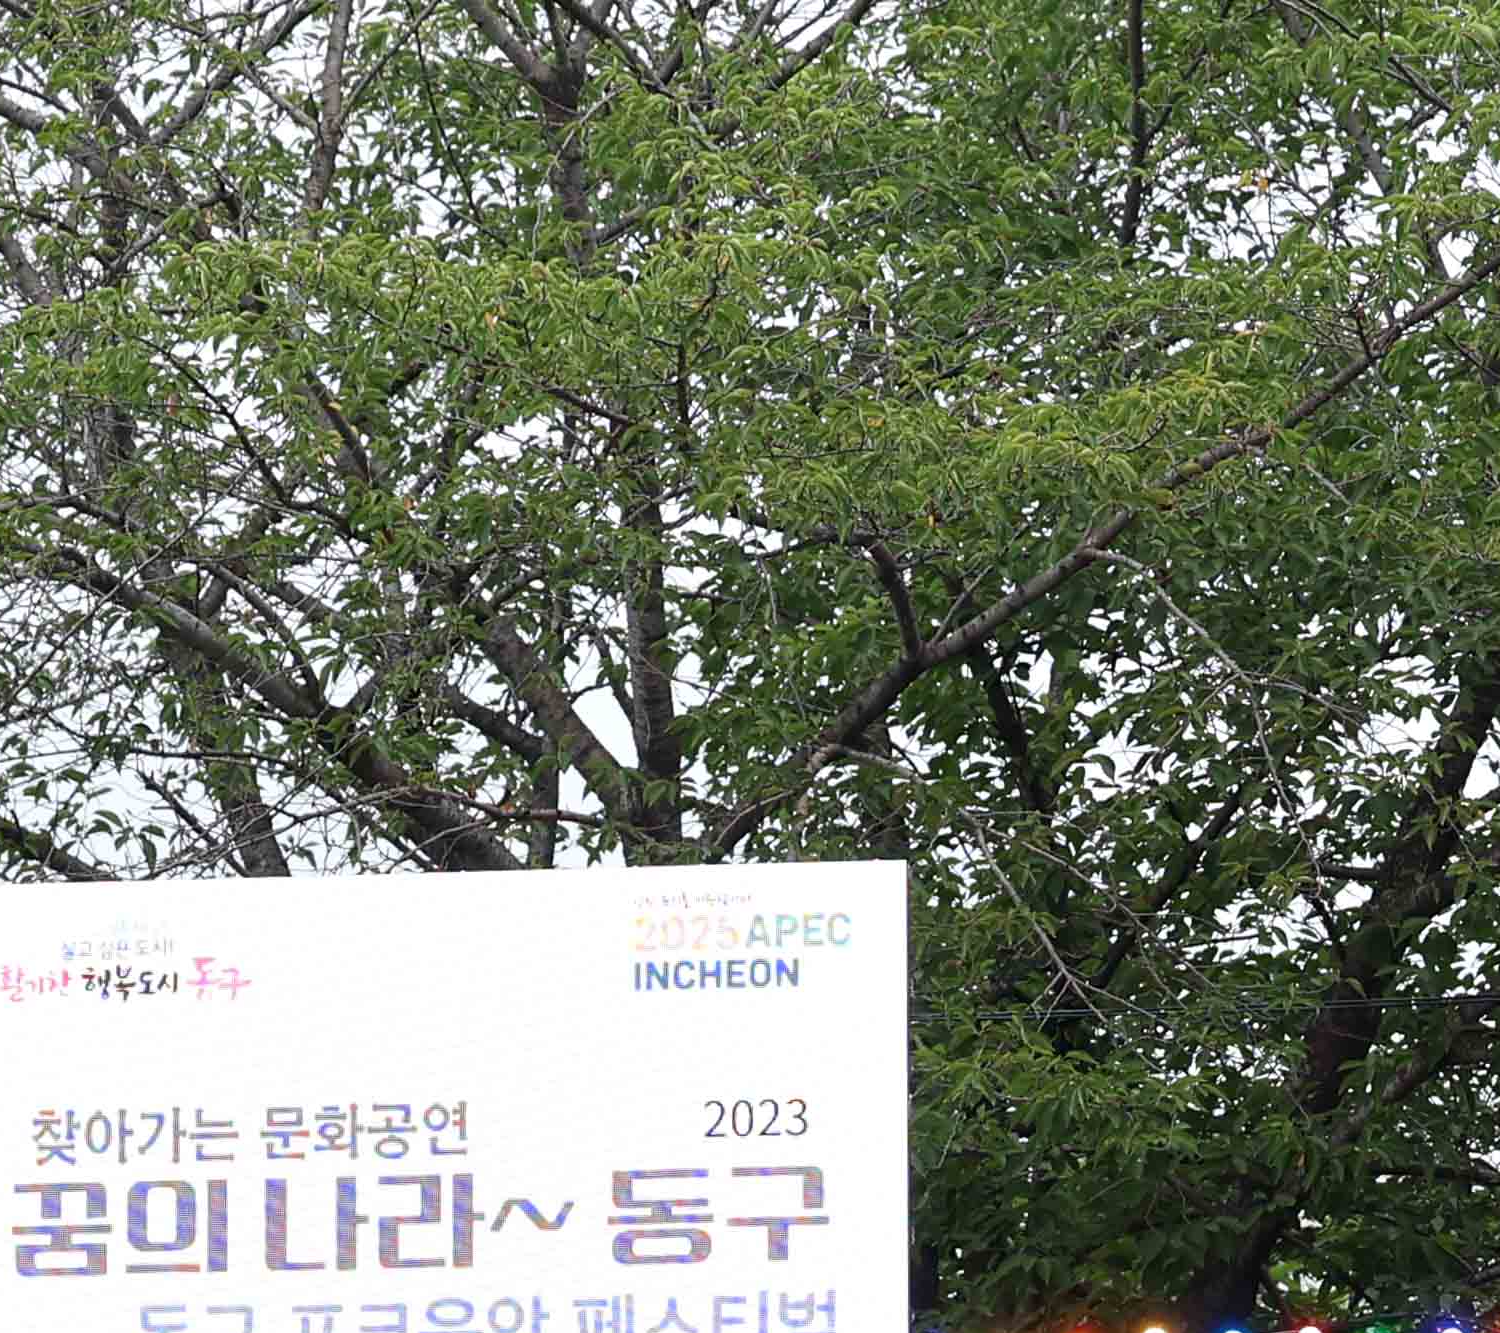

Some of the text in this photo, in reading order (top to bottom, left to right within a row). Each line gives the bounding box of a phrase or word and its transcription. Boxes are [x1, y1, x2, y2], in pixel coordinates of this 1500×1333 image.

[745, 912, 852, 949] APEC
[81, 962, 179, 1002] 행복도시
[634, 958, 800, 991] INCHEON
[33, 1101, 470, 1166] 찾아가는 문화공연
[703, 1098, 810, 1139] 2023
[12, 1178, 229, 1277] 꿈의
[607, 1165, 831, 1265] 동구
